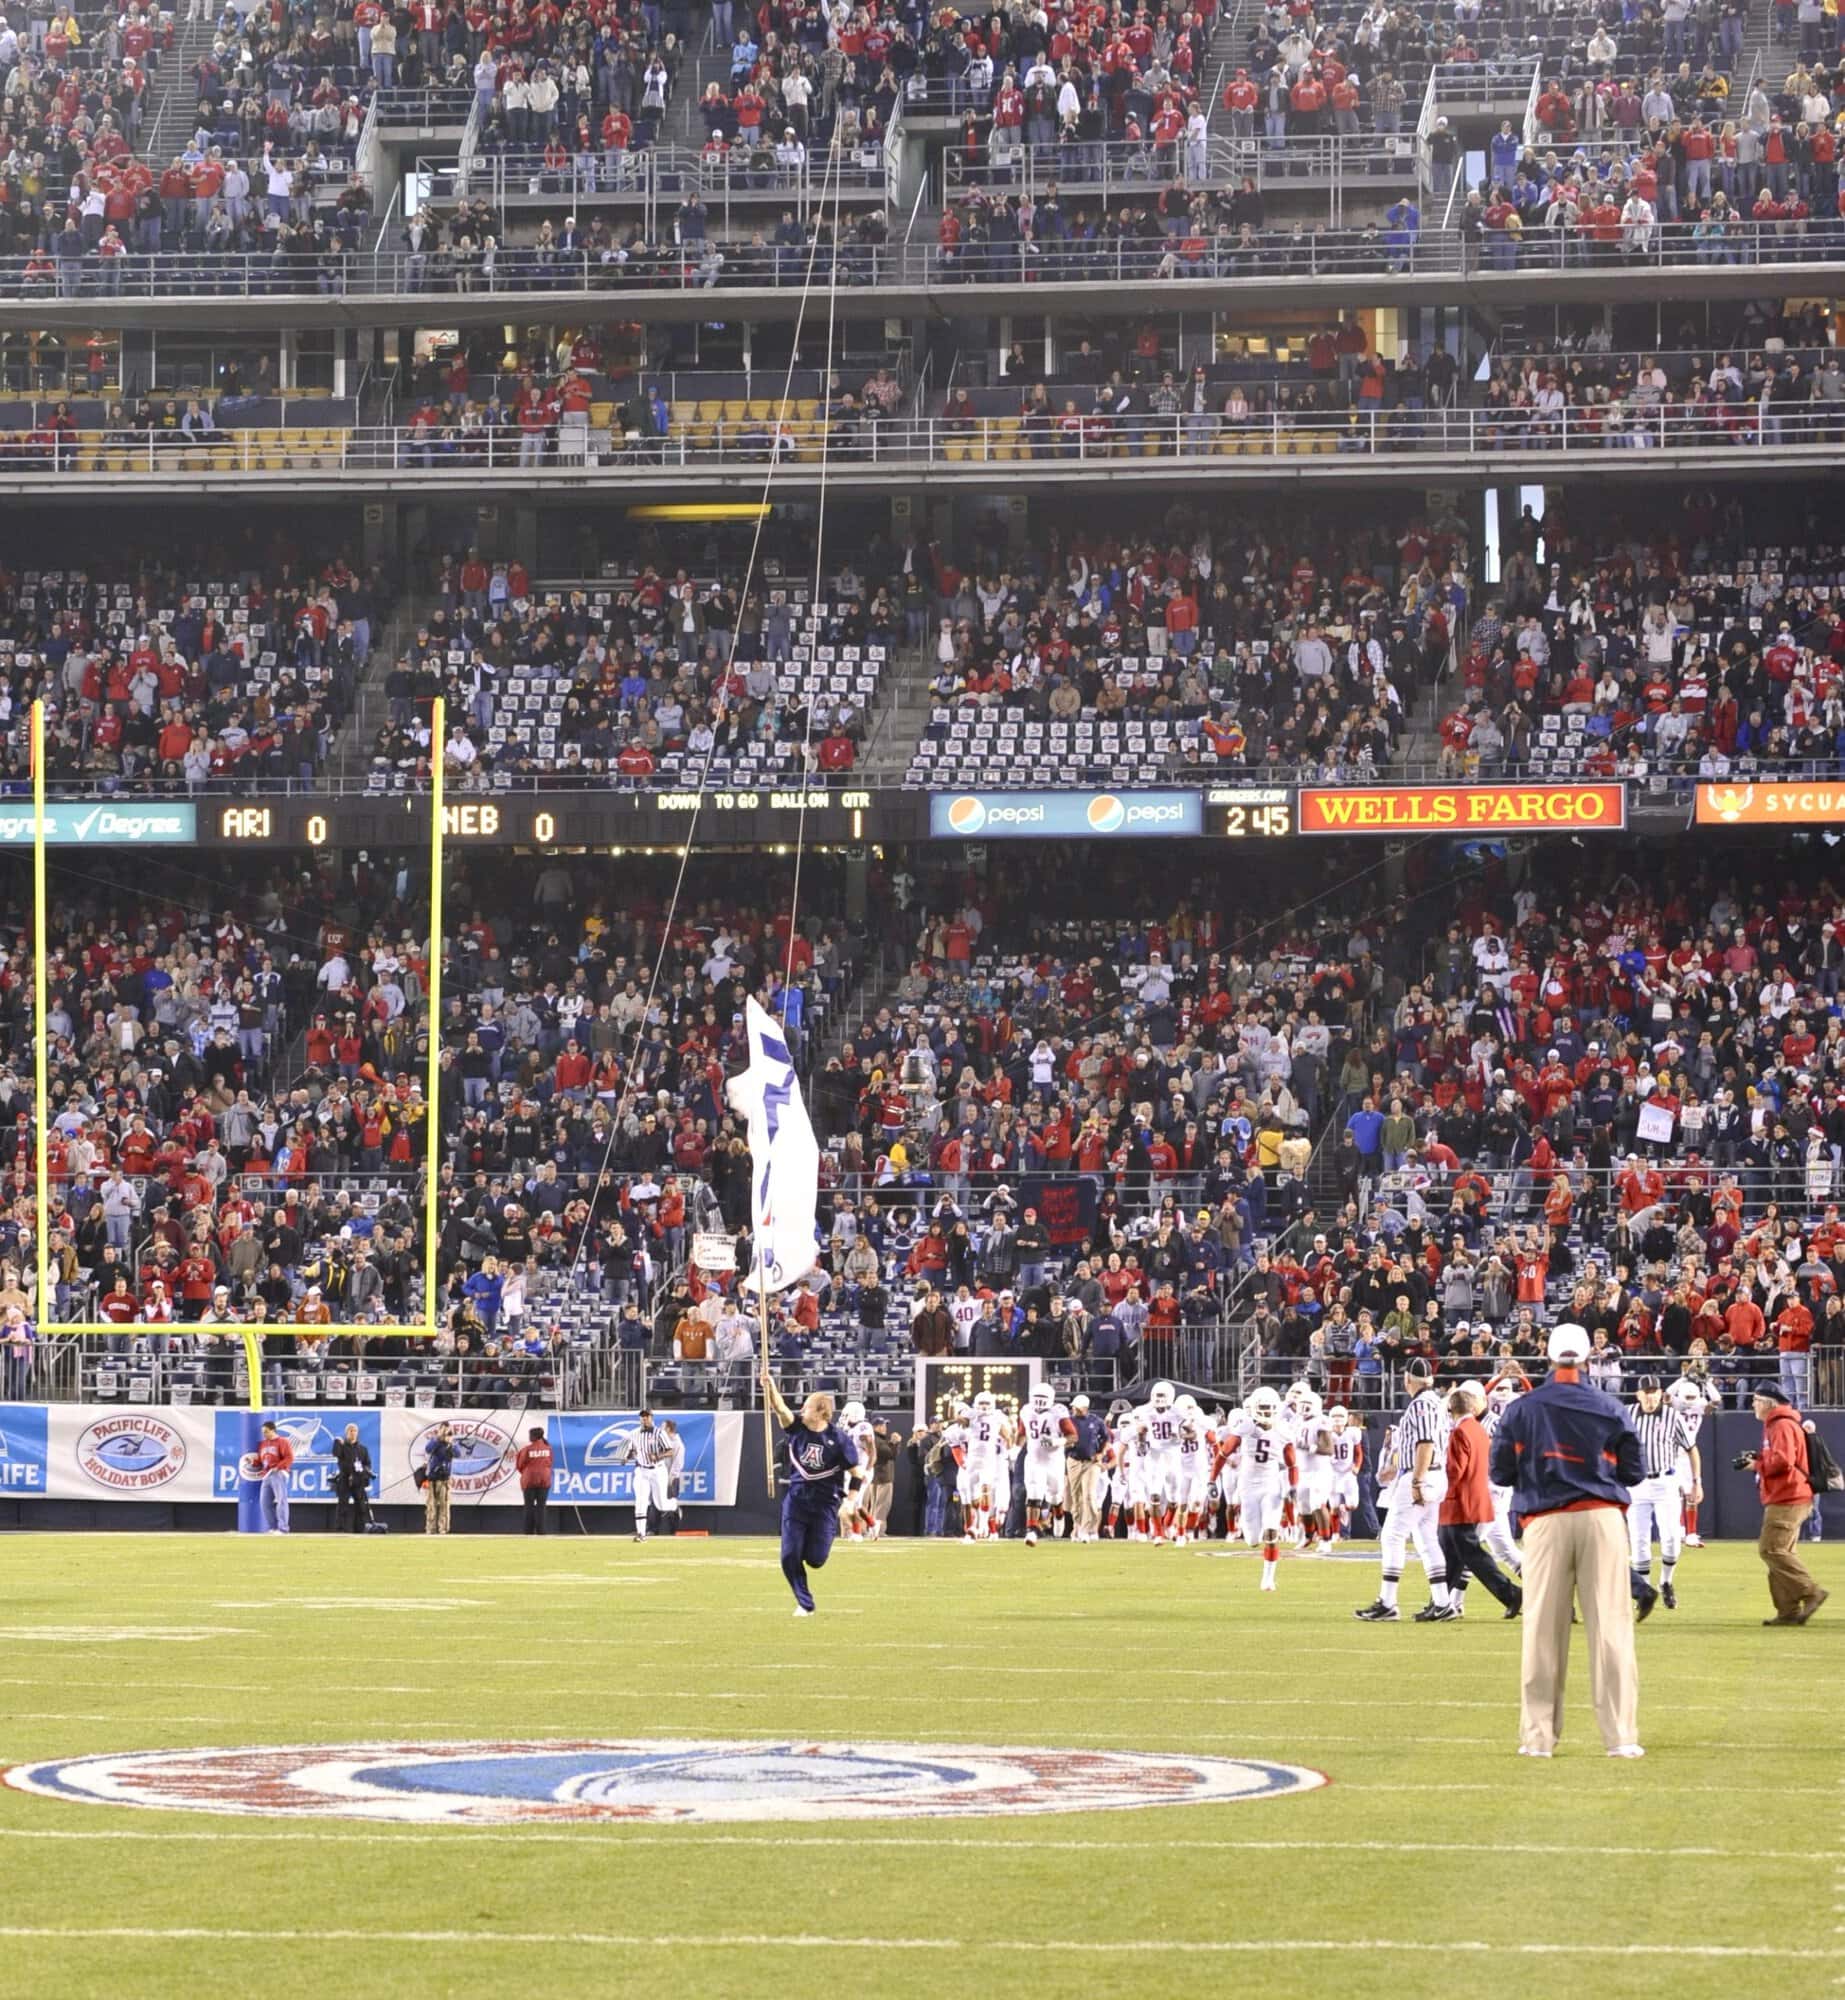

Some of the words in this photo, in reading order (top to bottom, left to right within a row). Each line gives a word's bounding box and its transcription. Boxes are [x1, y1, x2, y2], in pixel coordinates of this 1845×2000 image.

[658, 794, 702, 810] DOWN
[714, 793, 733, 809] TO
[737, 793, 759, 809] GO
[770, 793, 807, 809] BALL
[808, 793, 830, 809] ON
[841, 792, 871, 808] QTR
[1315, 795, 1457, 825] WELLS
[1466, 792, 1605, 823] FARGO
[223, 807, 271, 838] ARI
[441, 805, 499, 835] NEB
[987, 804, 1045, 825] pepsi
[1126, 803, 1184, 824] pepsi
[98, 812, 183, 839] Degree
[307, 815, 327, 845] 0
[535, 812, 555, 842] 0
[955, 1306, 974, 1322] 40
[91, 1418, 145, 1441] PACIFIC
[143, 1420, 173, 1443] LIFE
[475, 1425, 504, 1446] LIFE
[979, 1422, 991, 1442] 2
[1029, 1418, 1052, 1440] 54
[1151, 1420, 1173, 1441] 20
[1255, 1439, 1271, 1464] 5
[0, 1463, 40, 1486] IFE
[84, 1456, 139, 1487] HOLIDAY
[140, 1463, 177, 1487] BOWL
[553, 1468, 634, 1495] PACIFI
